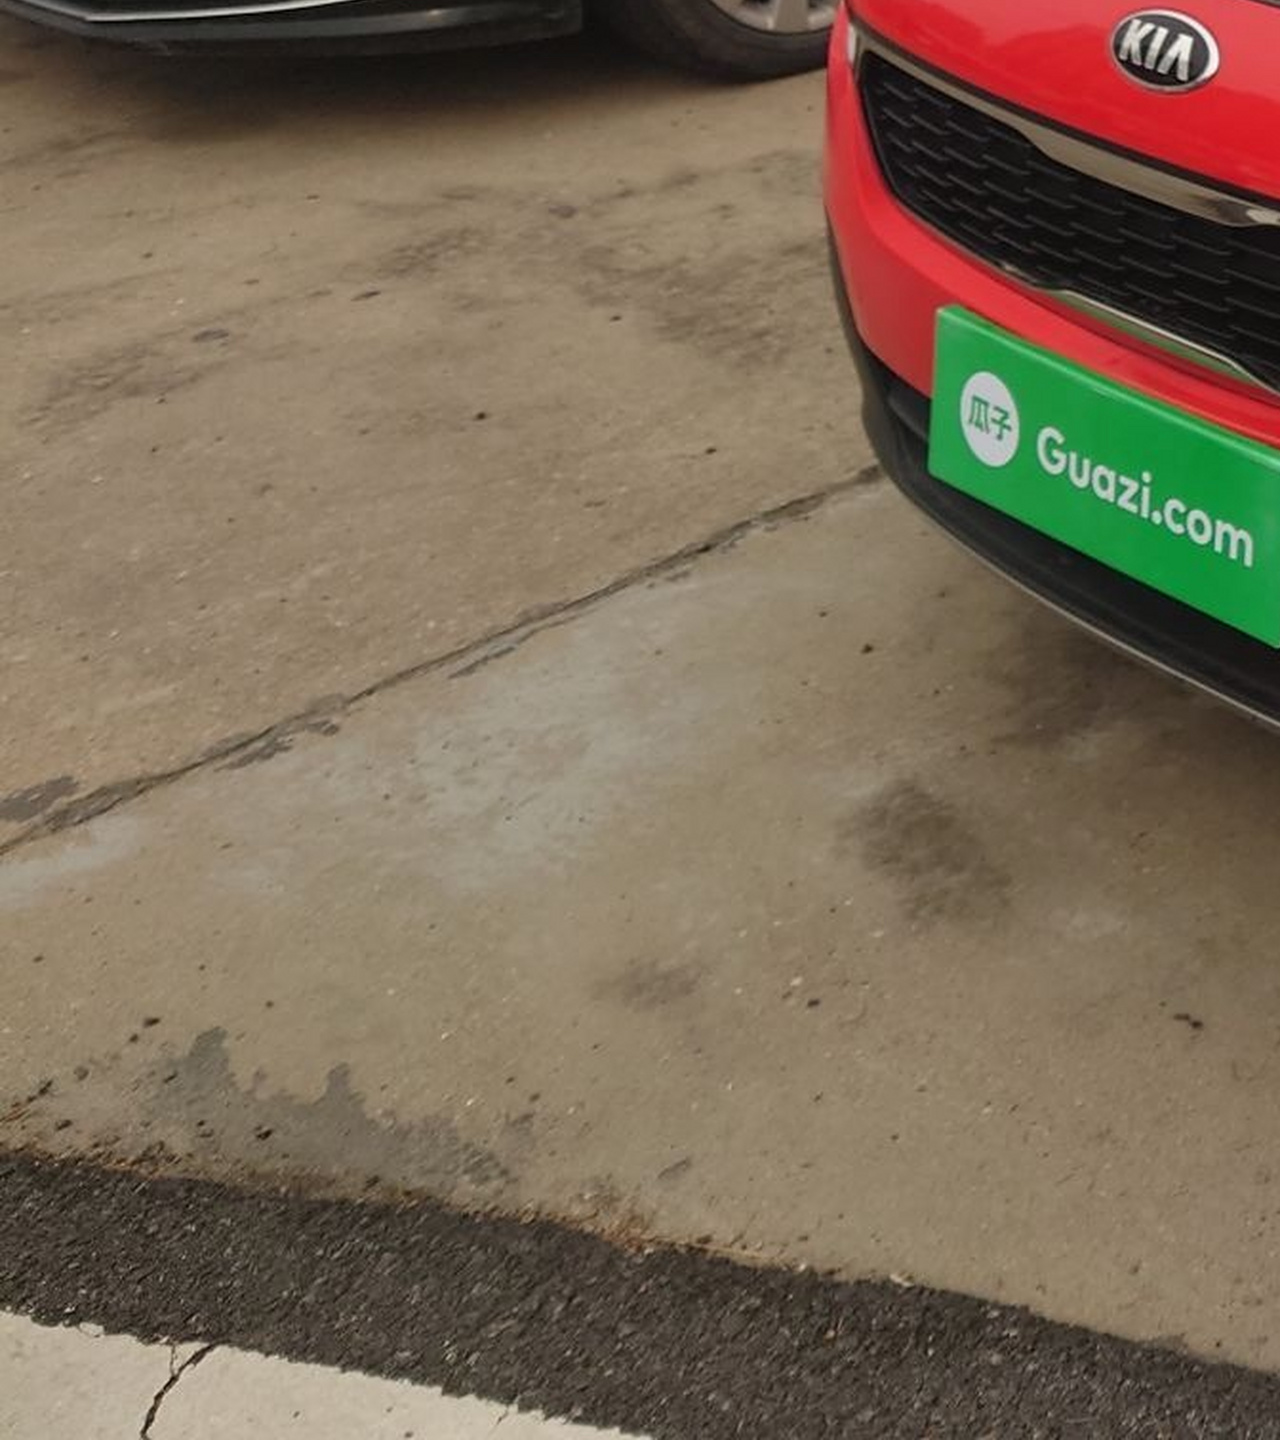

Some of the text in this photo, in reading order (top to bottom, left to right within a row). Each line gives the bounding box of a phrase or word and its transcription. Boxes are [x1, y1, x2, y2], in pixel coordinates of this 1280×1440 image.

[1118, 18, 1194, 82] KIA
[968, 395, 1012, 441] 瓜子
[1036, 426, 1255, 568] Guazi.com
